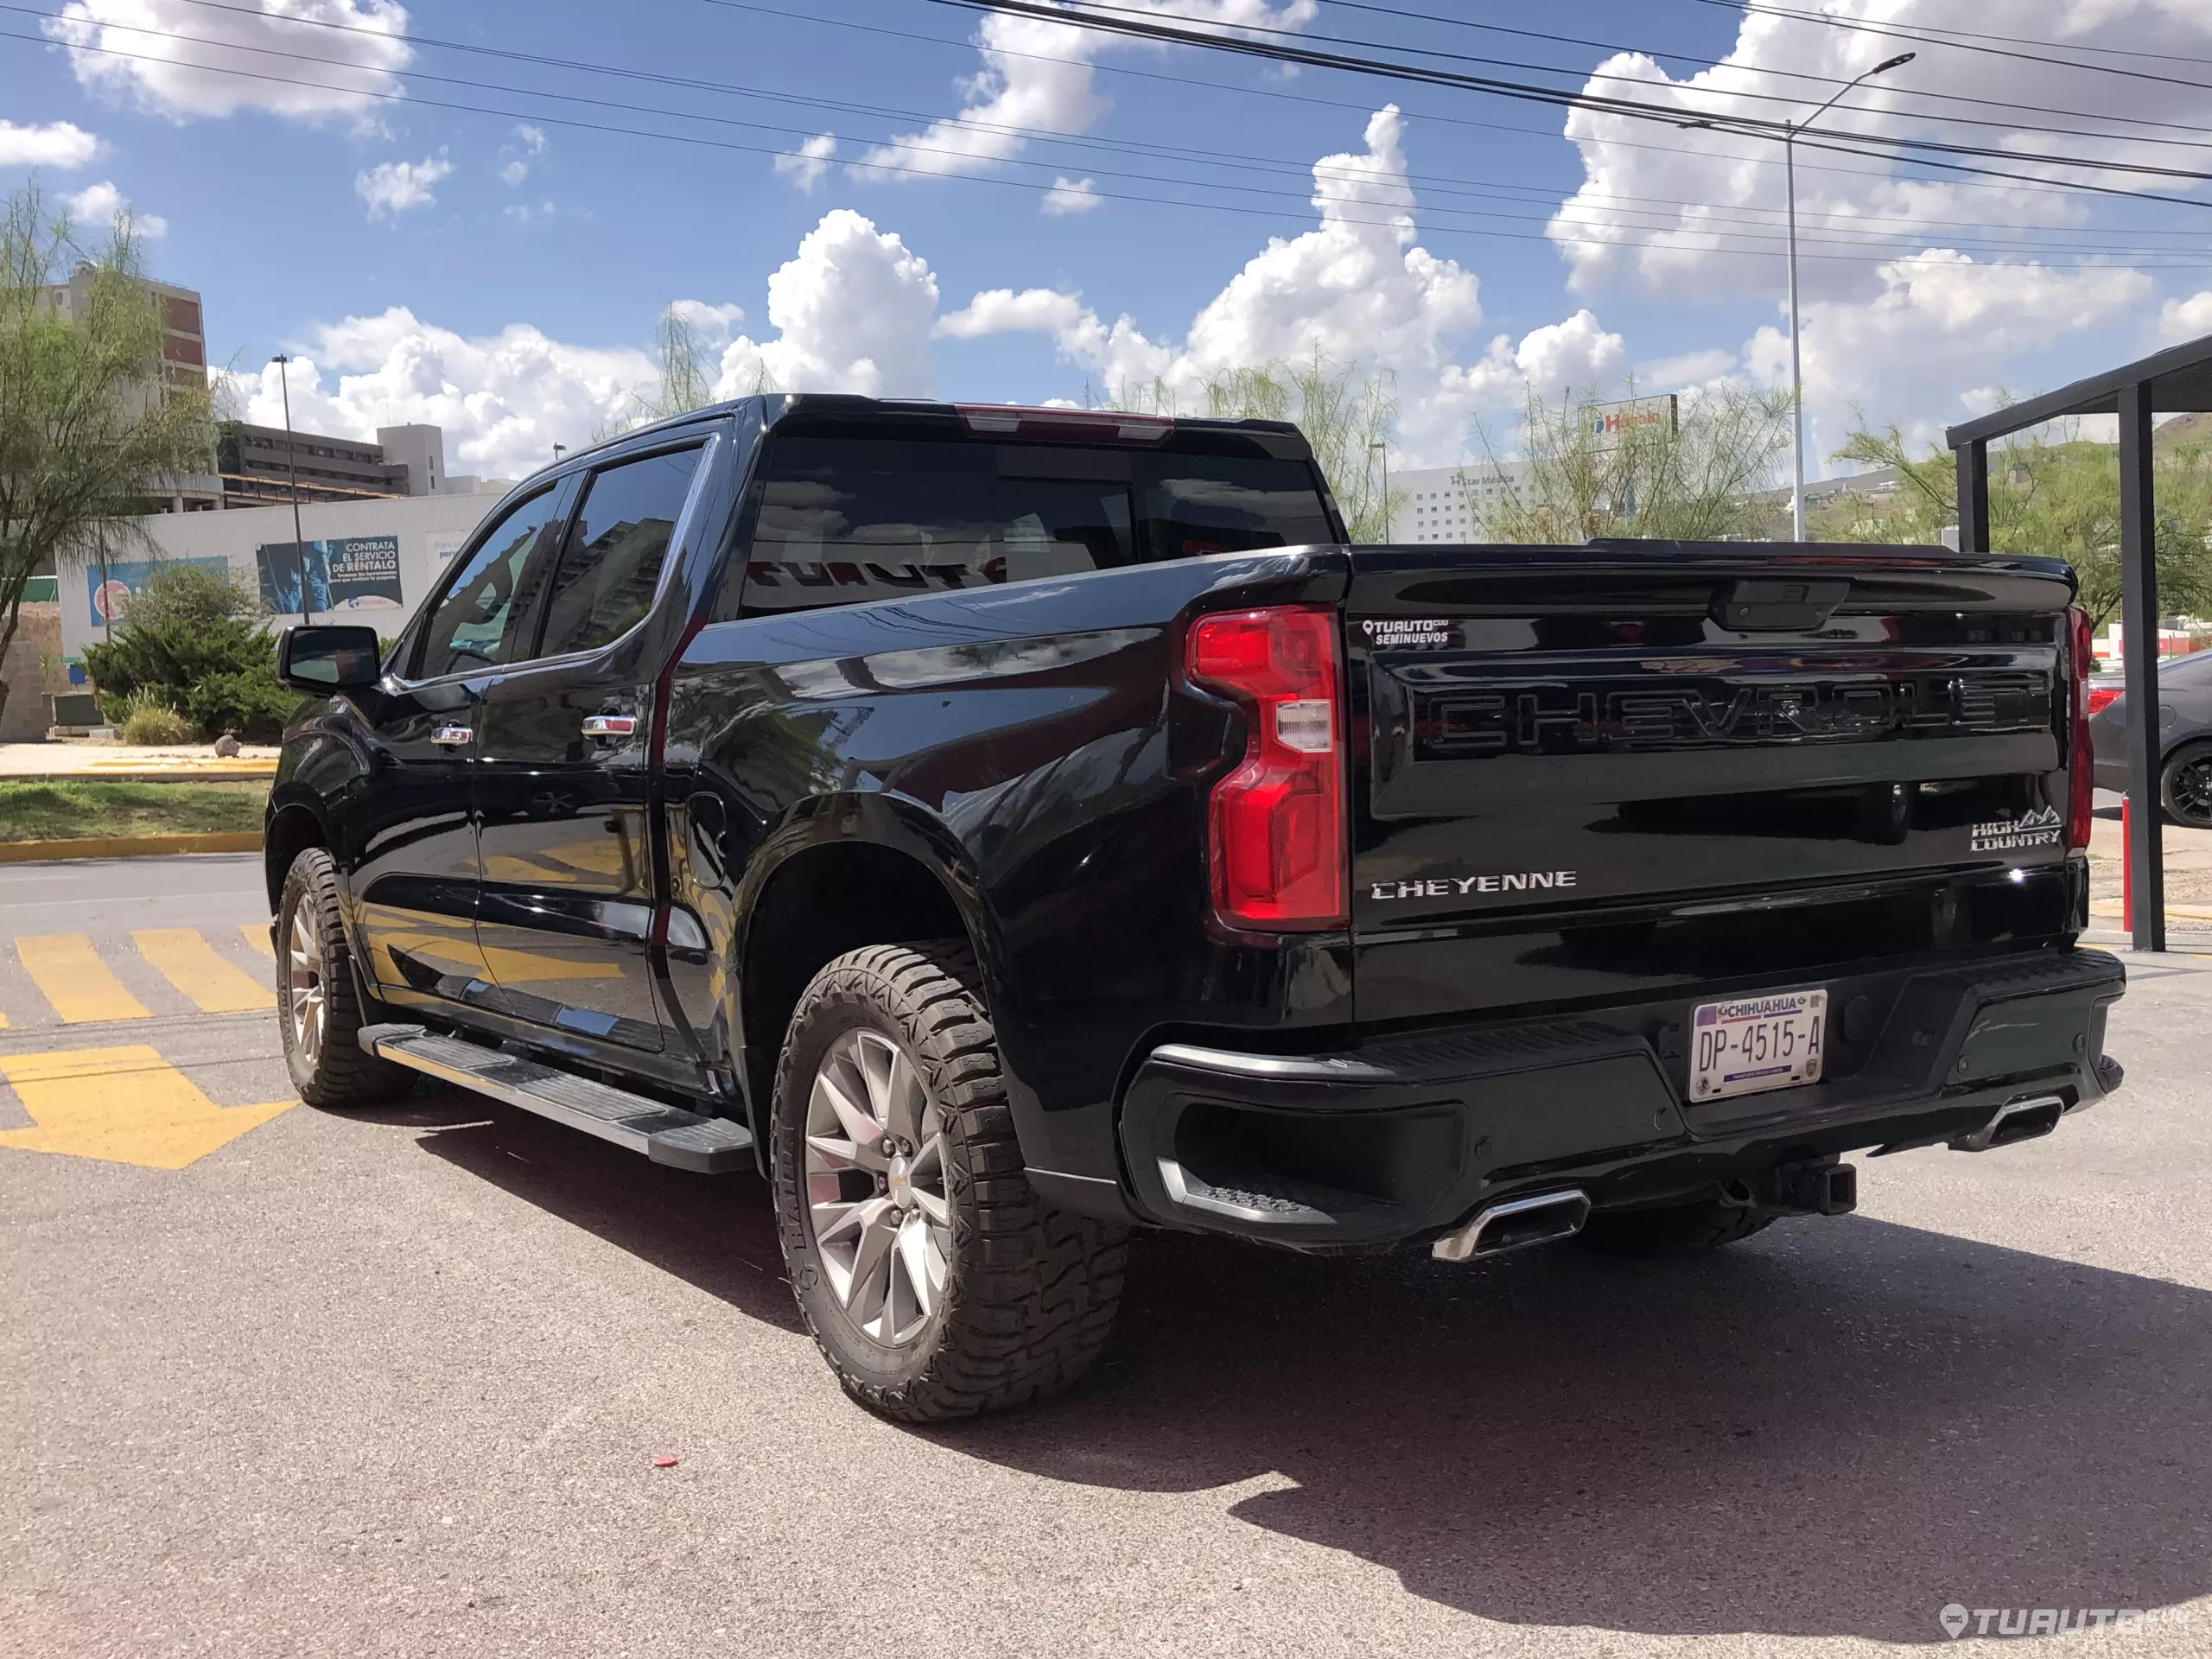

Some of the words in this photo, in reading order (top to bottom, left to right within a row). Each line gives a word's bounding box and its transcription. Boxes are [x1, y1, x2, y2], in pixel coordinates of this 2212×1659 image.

[342, 553, 352, 562] EL
[354, 550, 396, 561] SERVICIO
[346, 541, 395, 552] CONTRATA
[333, 563, 344, 573] DE
[1376, 632, 1448, 645] SEMINUEVOS
[1427, 678, 2046, 749] CHEVROLET
[1972, 820, 2019, 837] HIGH
[1971, 830, 2061, 851] COUNTRY
[1371, 870, 1577, 899] CHEYENNE
[1728, 997, 1797, 1018] CHIHUAHUA
[1699, 1015, 1820, 1072] DP-4515-A
